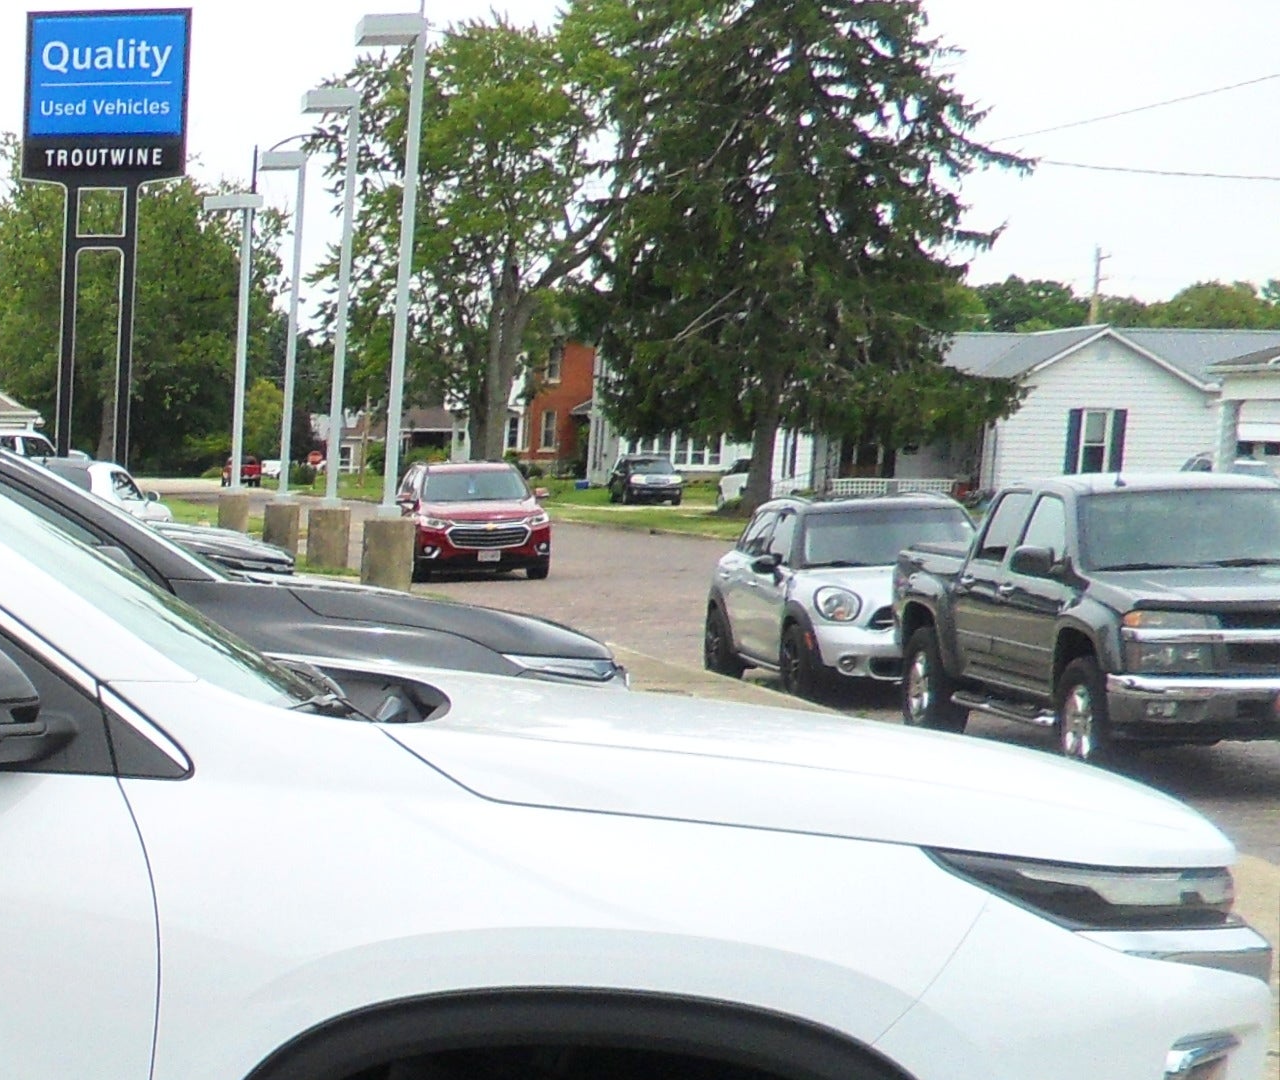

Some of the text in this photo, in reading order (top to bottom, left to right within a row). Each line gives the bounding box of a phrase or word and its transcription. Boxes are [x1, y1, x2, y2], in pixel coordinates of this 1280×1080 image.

[42, 38, 173, 78] Quality
[40, 98, 171, 116] Used Vehicles
[45, 148, 163, 167] TROUTWINE
